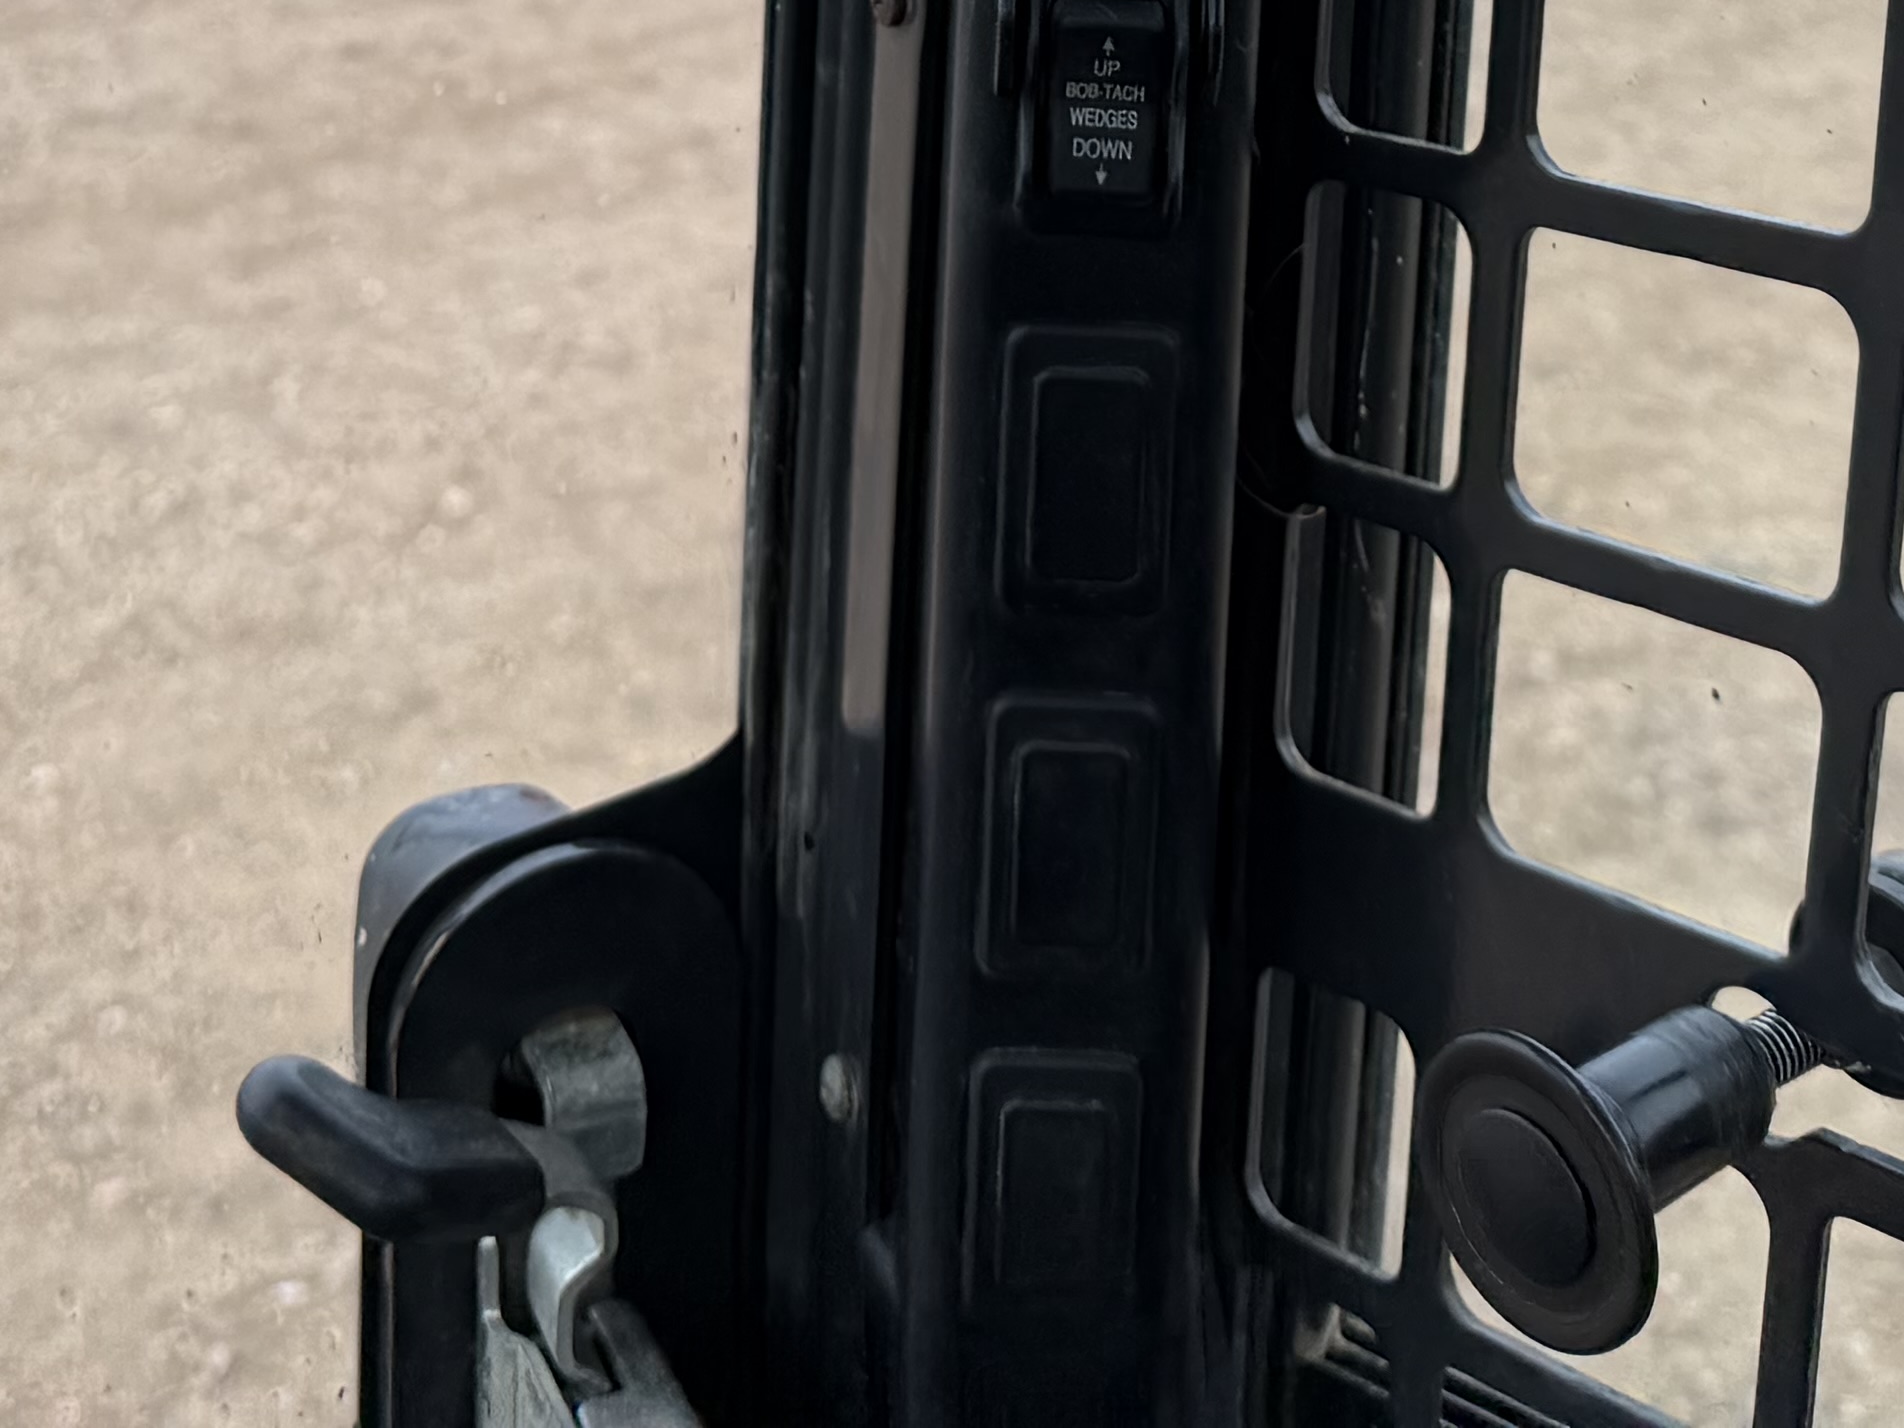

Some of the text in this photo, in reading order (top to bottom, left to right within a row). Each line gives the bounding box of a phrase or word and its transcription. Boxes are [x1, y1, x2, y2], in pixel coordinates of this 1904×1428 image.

[1094, 59, 1121, 77] UP
[1065, 81, 1145, 103] BOB-TACH
[1069, 106, 1138, 130] WEDGES
[1071, 137, 1133, 161] DOWN
